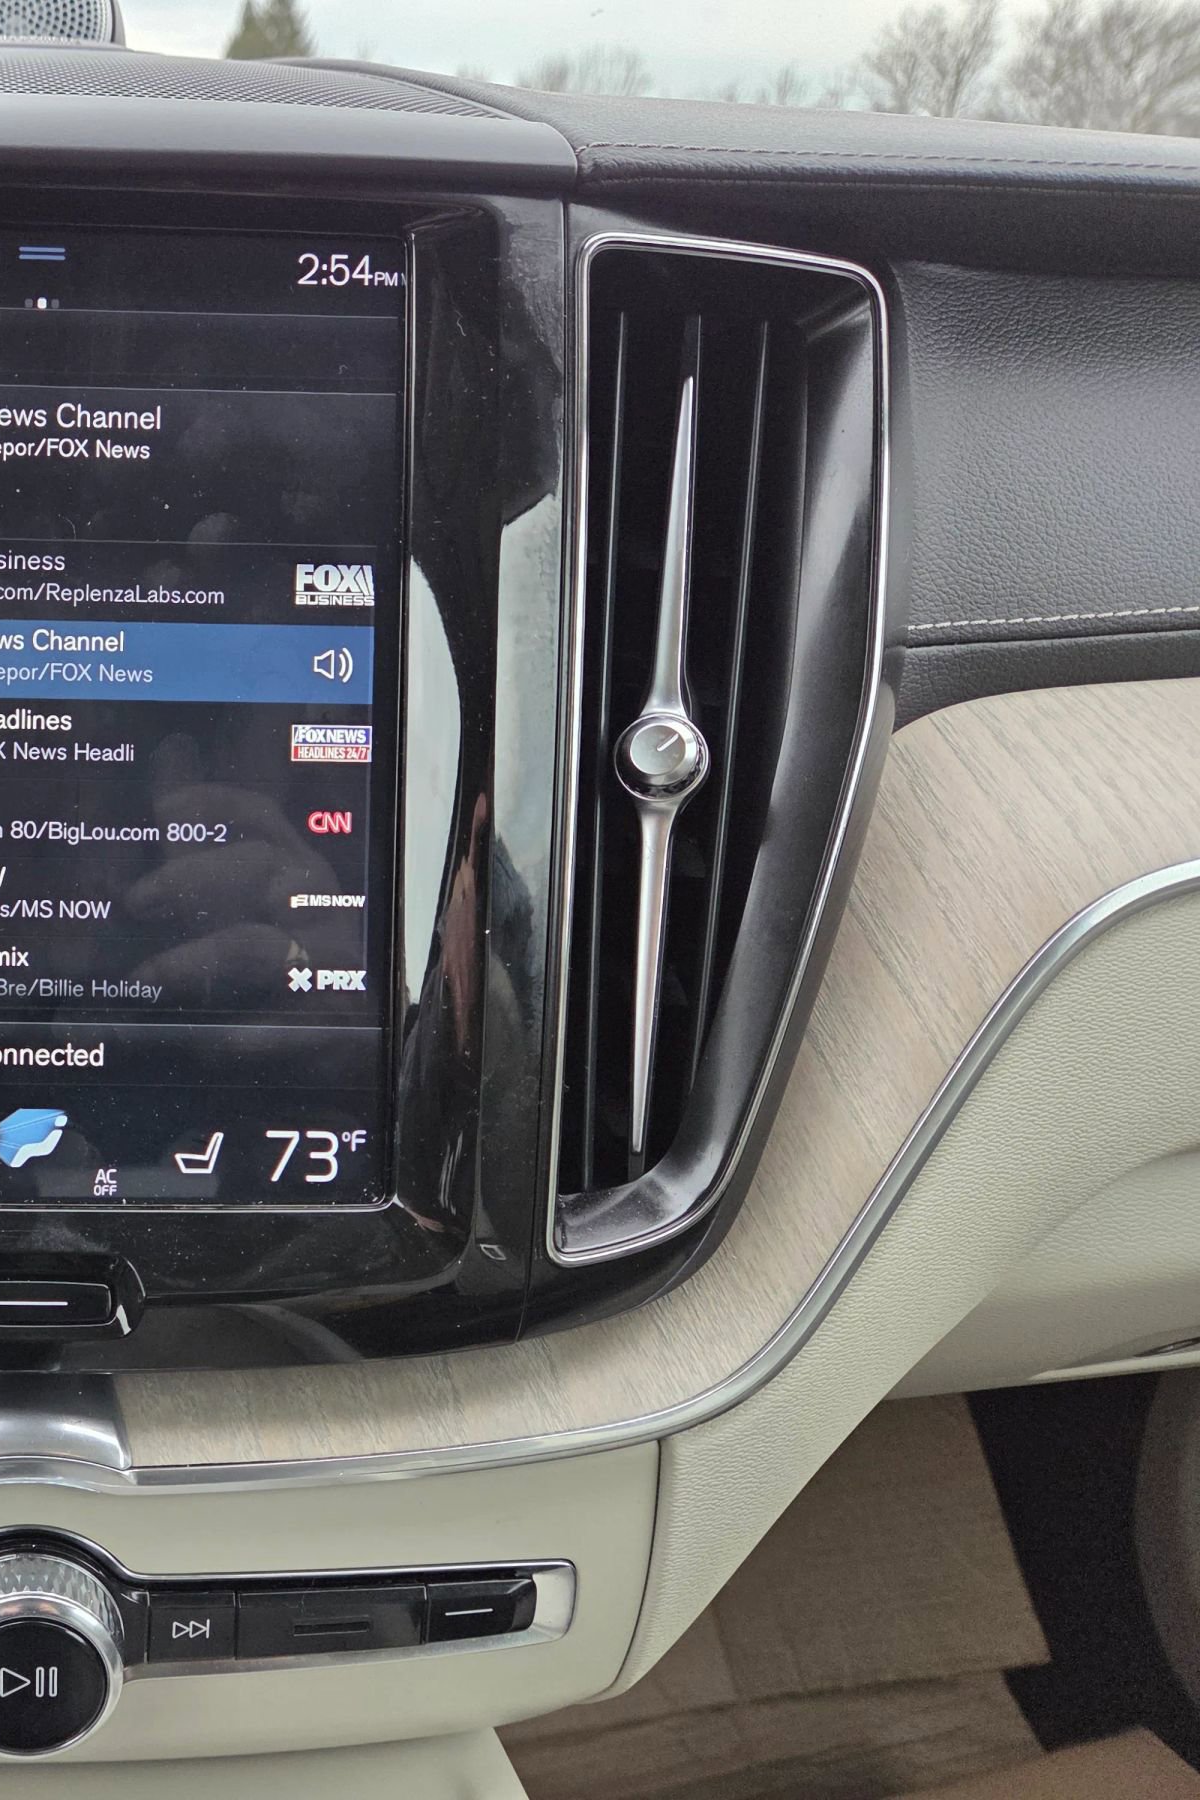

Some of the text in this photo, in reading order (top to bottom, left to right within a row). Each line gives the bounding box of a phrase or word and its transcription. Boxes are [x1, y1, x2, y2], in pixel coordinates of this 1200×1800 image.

[56, 402, 161, 430] Channel
[95, 438, 151, 460] News
[295, 563, 362, 593] FOX
[295, 594, 375, 607] BUSINESS
[32, 628, 124, 652] Channel
[99, 663, 153, 683] News
[13, 741, 67, 761] News
[74, 742, 135, 762] Headli
[298, 746, 345, 759] HEADLINES
[10, 820, 160, 846] 80/BigLou.com
[166, 822, 228, 843] 800-2
[307, 811, 353, 834] CNN
[59, 899, 112, 920] NOW
[91, 979, 163, 1002] Holiday
[316, 969, 367, 991] PRX
[94, 1168, 118, 1184] AC
[93, 1185, 118, 1197] OFF
